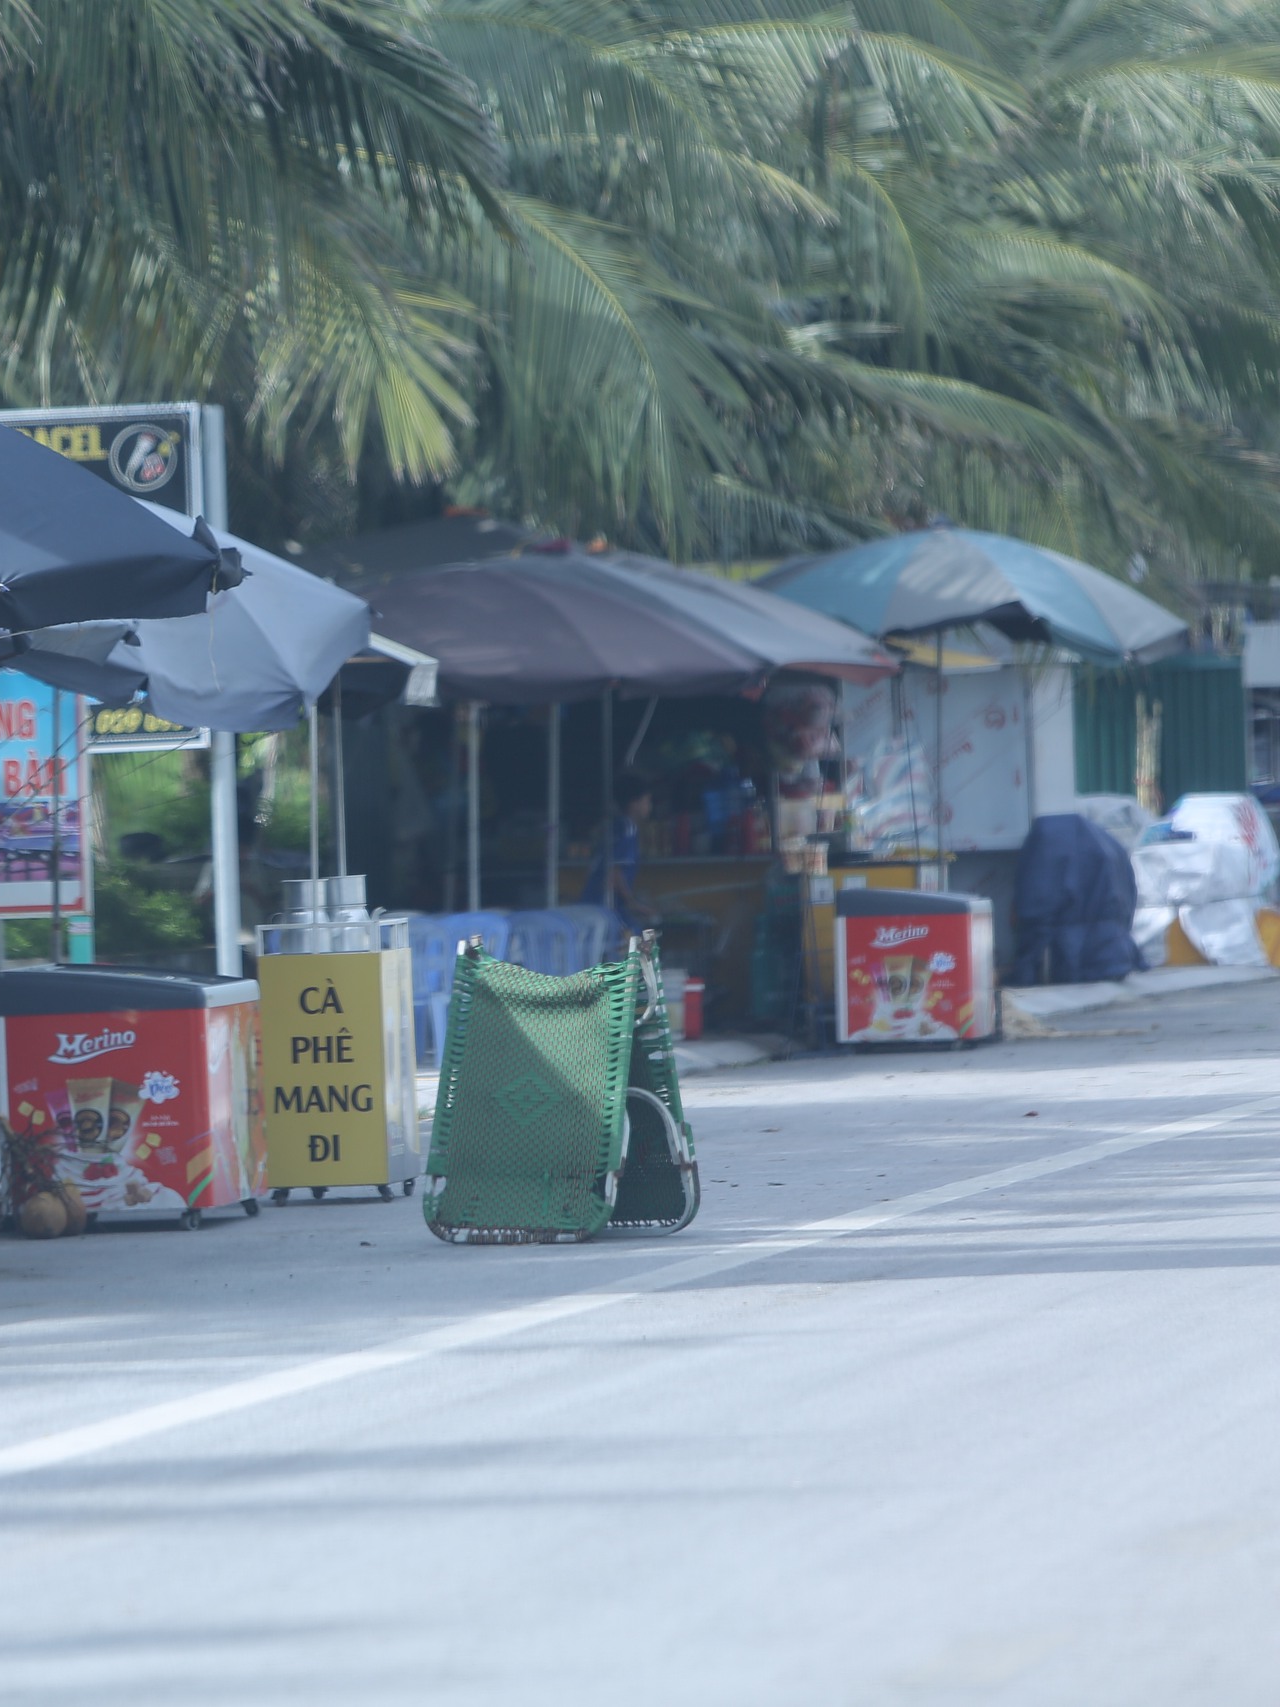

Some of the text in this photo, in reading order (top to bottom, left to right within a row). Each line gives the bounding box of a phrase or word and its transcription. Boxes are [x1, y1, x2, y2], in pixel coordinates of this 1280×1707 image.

[875, 925, 929, 943] Merino
[299, 978, 344, 1015] CÀ
[53, 1028, 136, 1060] Merino
[291, 1027, 355, 1064] PHÊ
[273, 1084, 373, 1114] MANG
[308, 1134, 340, 1163] ĐI
